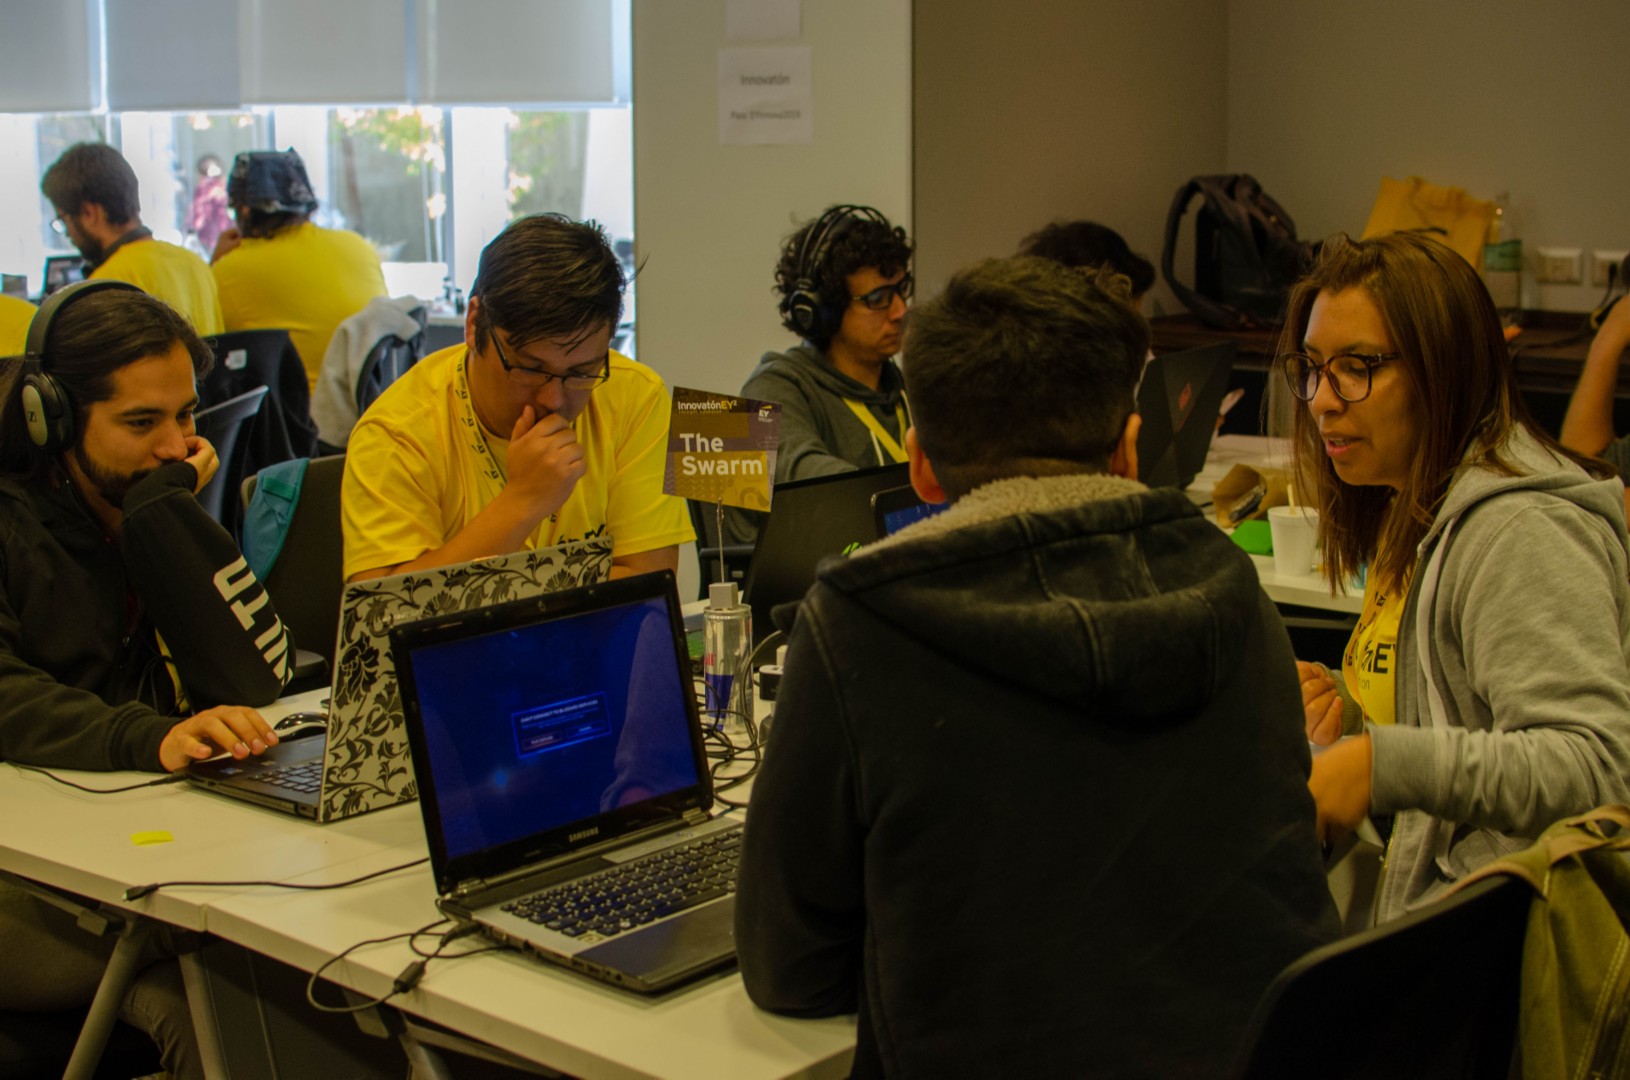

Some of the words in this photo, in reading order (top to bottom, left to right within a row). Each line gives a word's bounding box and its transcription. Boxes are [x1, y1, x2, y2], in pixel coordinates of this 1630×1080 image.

[758, 409, 770, 418] EY
[679, 433, 724, 453] The
[682, 455, 763, 476] Swarm
